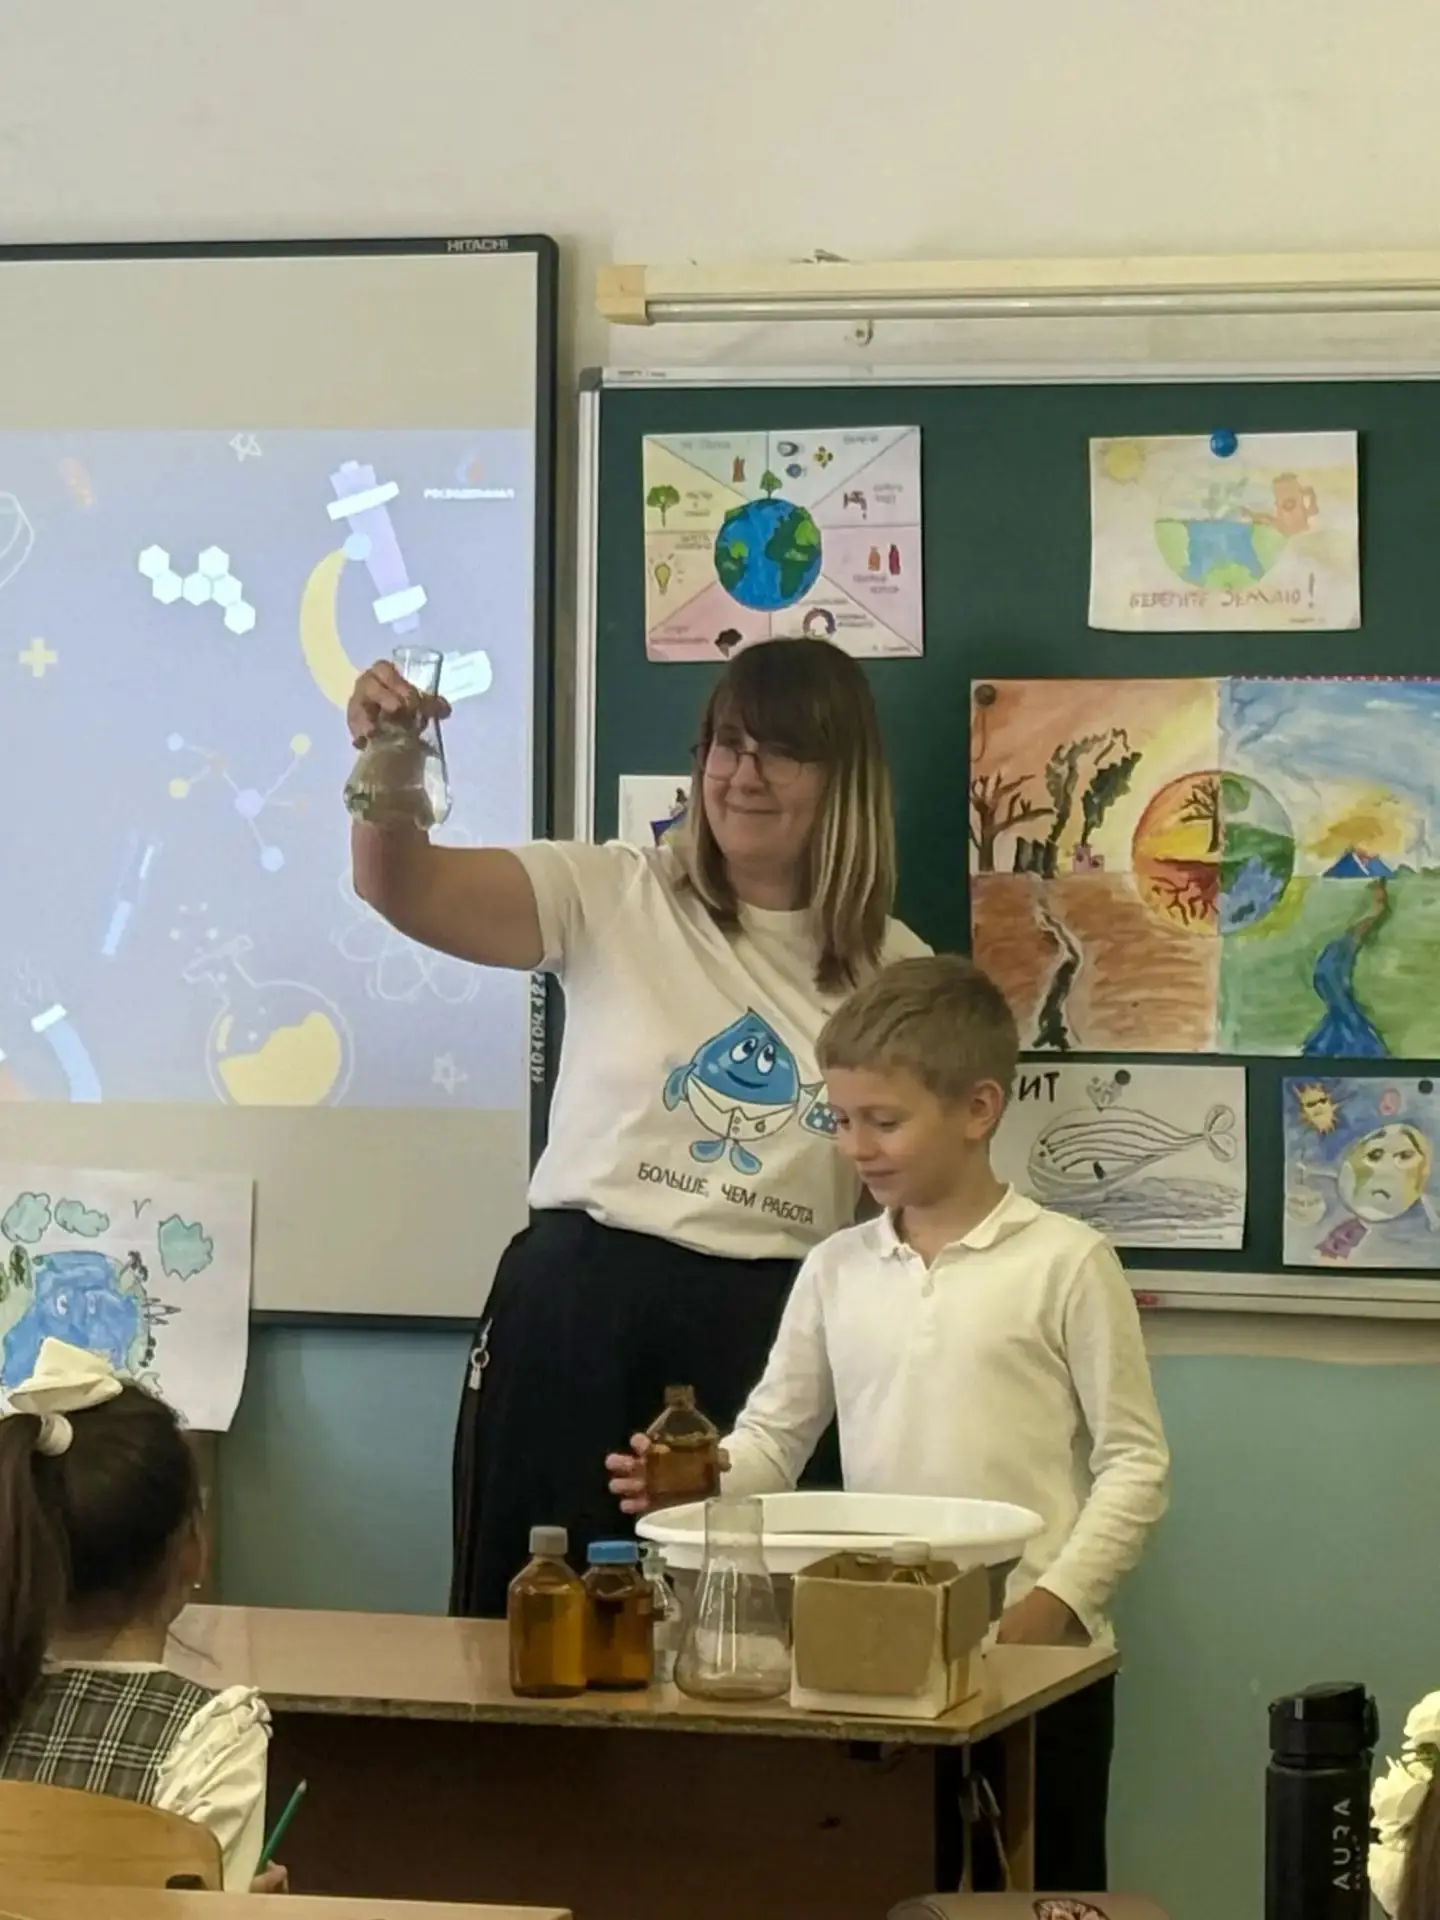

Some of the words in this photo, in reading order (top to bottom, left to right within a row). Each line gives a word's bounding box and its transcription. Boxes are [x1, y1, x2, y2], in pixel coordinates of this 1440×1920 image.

[446, 239, 509, 252] HITACHI
[1018, 1071, 1060, 1104] ИТ
[721, 1183, 758, 1209] ЧЕМ
[761, 1196, 814, 1225] РАБОТА
[1332, 1798, 1351, 1890] AURA
